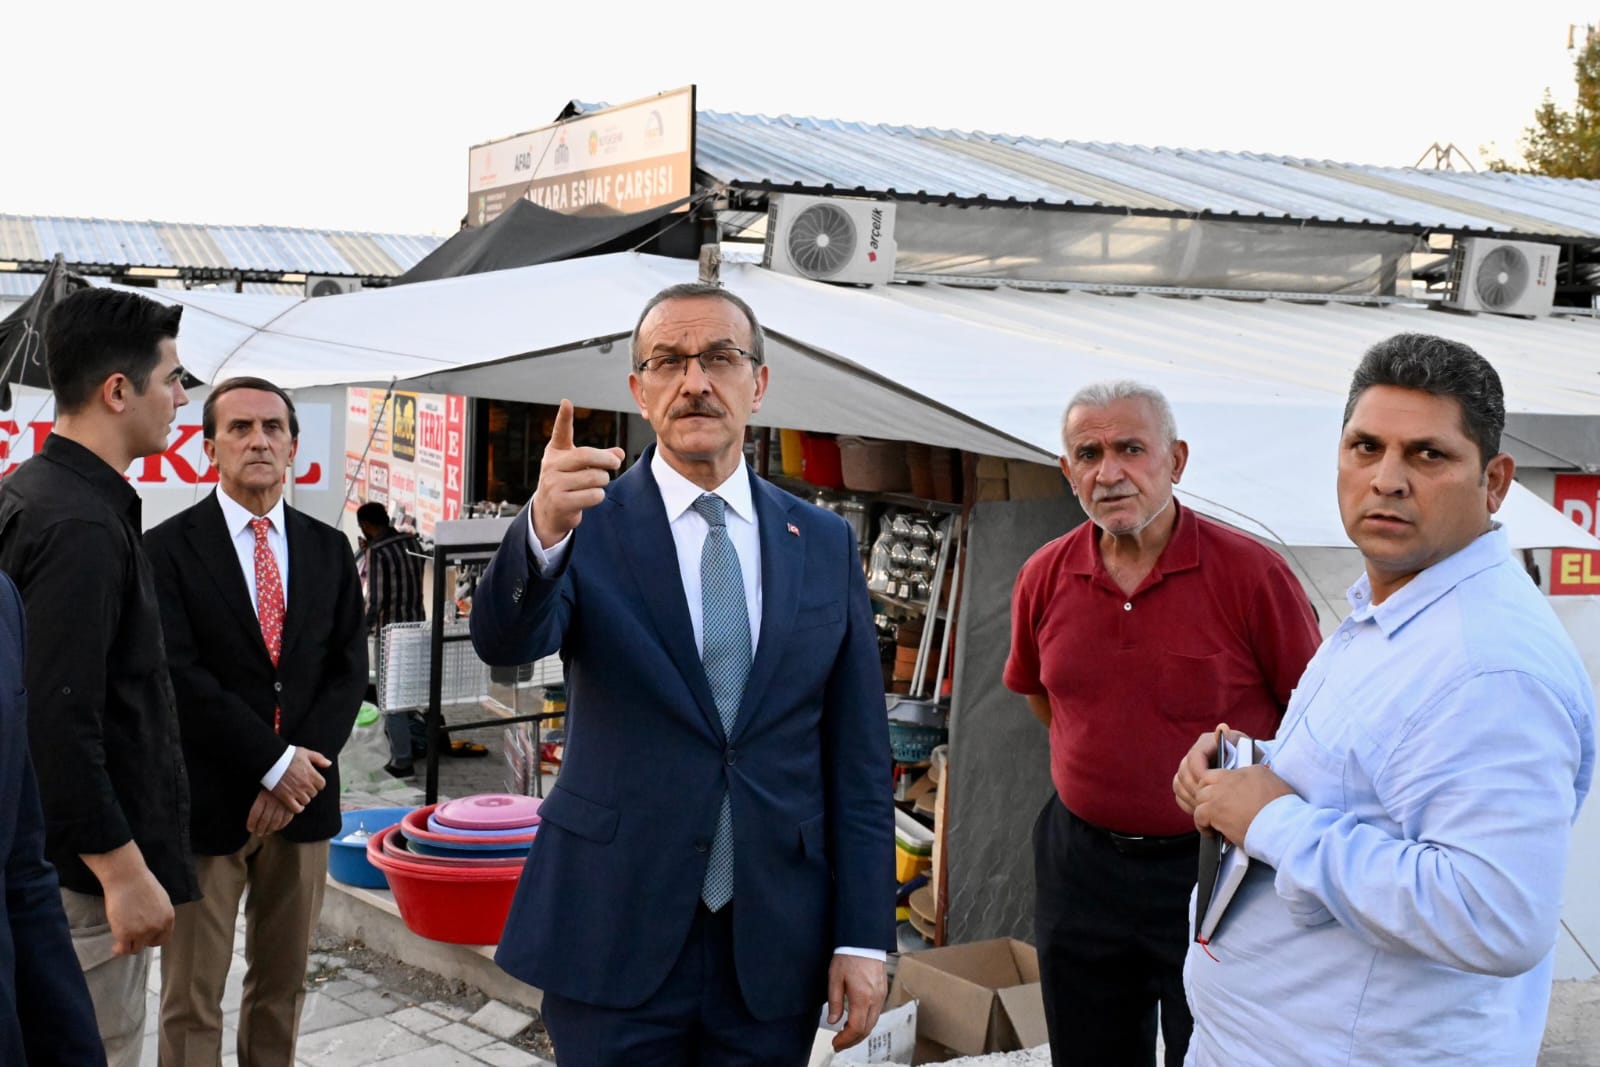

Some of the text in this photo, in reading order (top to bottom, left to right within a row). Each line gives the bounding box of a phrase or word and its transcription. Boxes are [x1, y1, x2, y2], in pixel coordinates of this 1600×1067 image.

[571, 175, 611, 207] ESNAF
[615, 165, 673, 209] ÇARŞISI
[869, 207, 884, 250] arçelik
[419, 410, 444, 452] TERZİ
